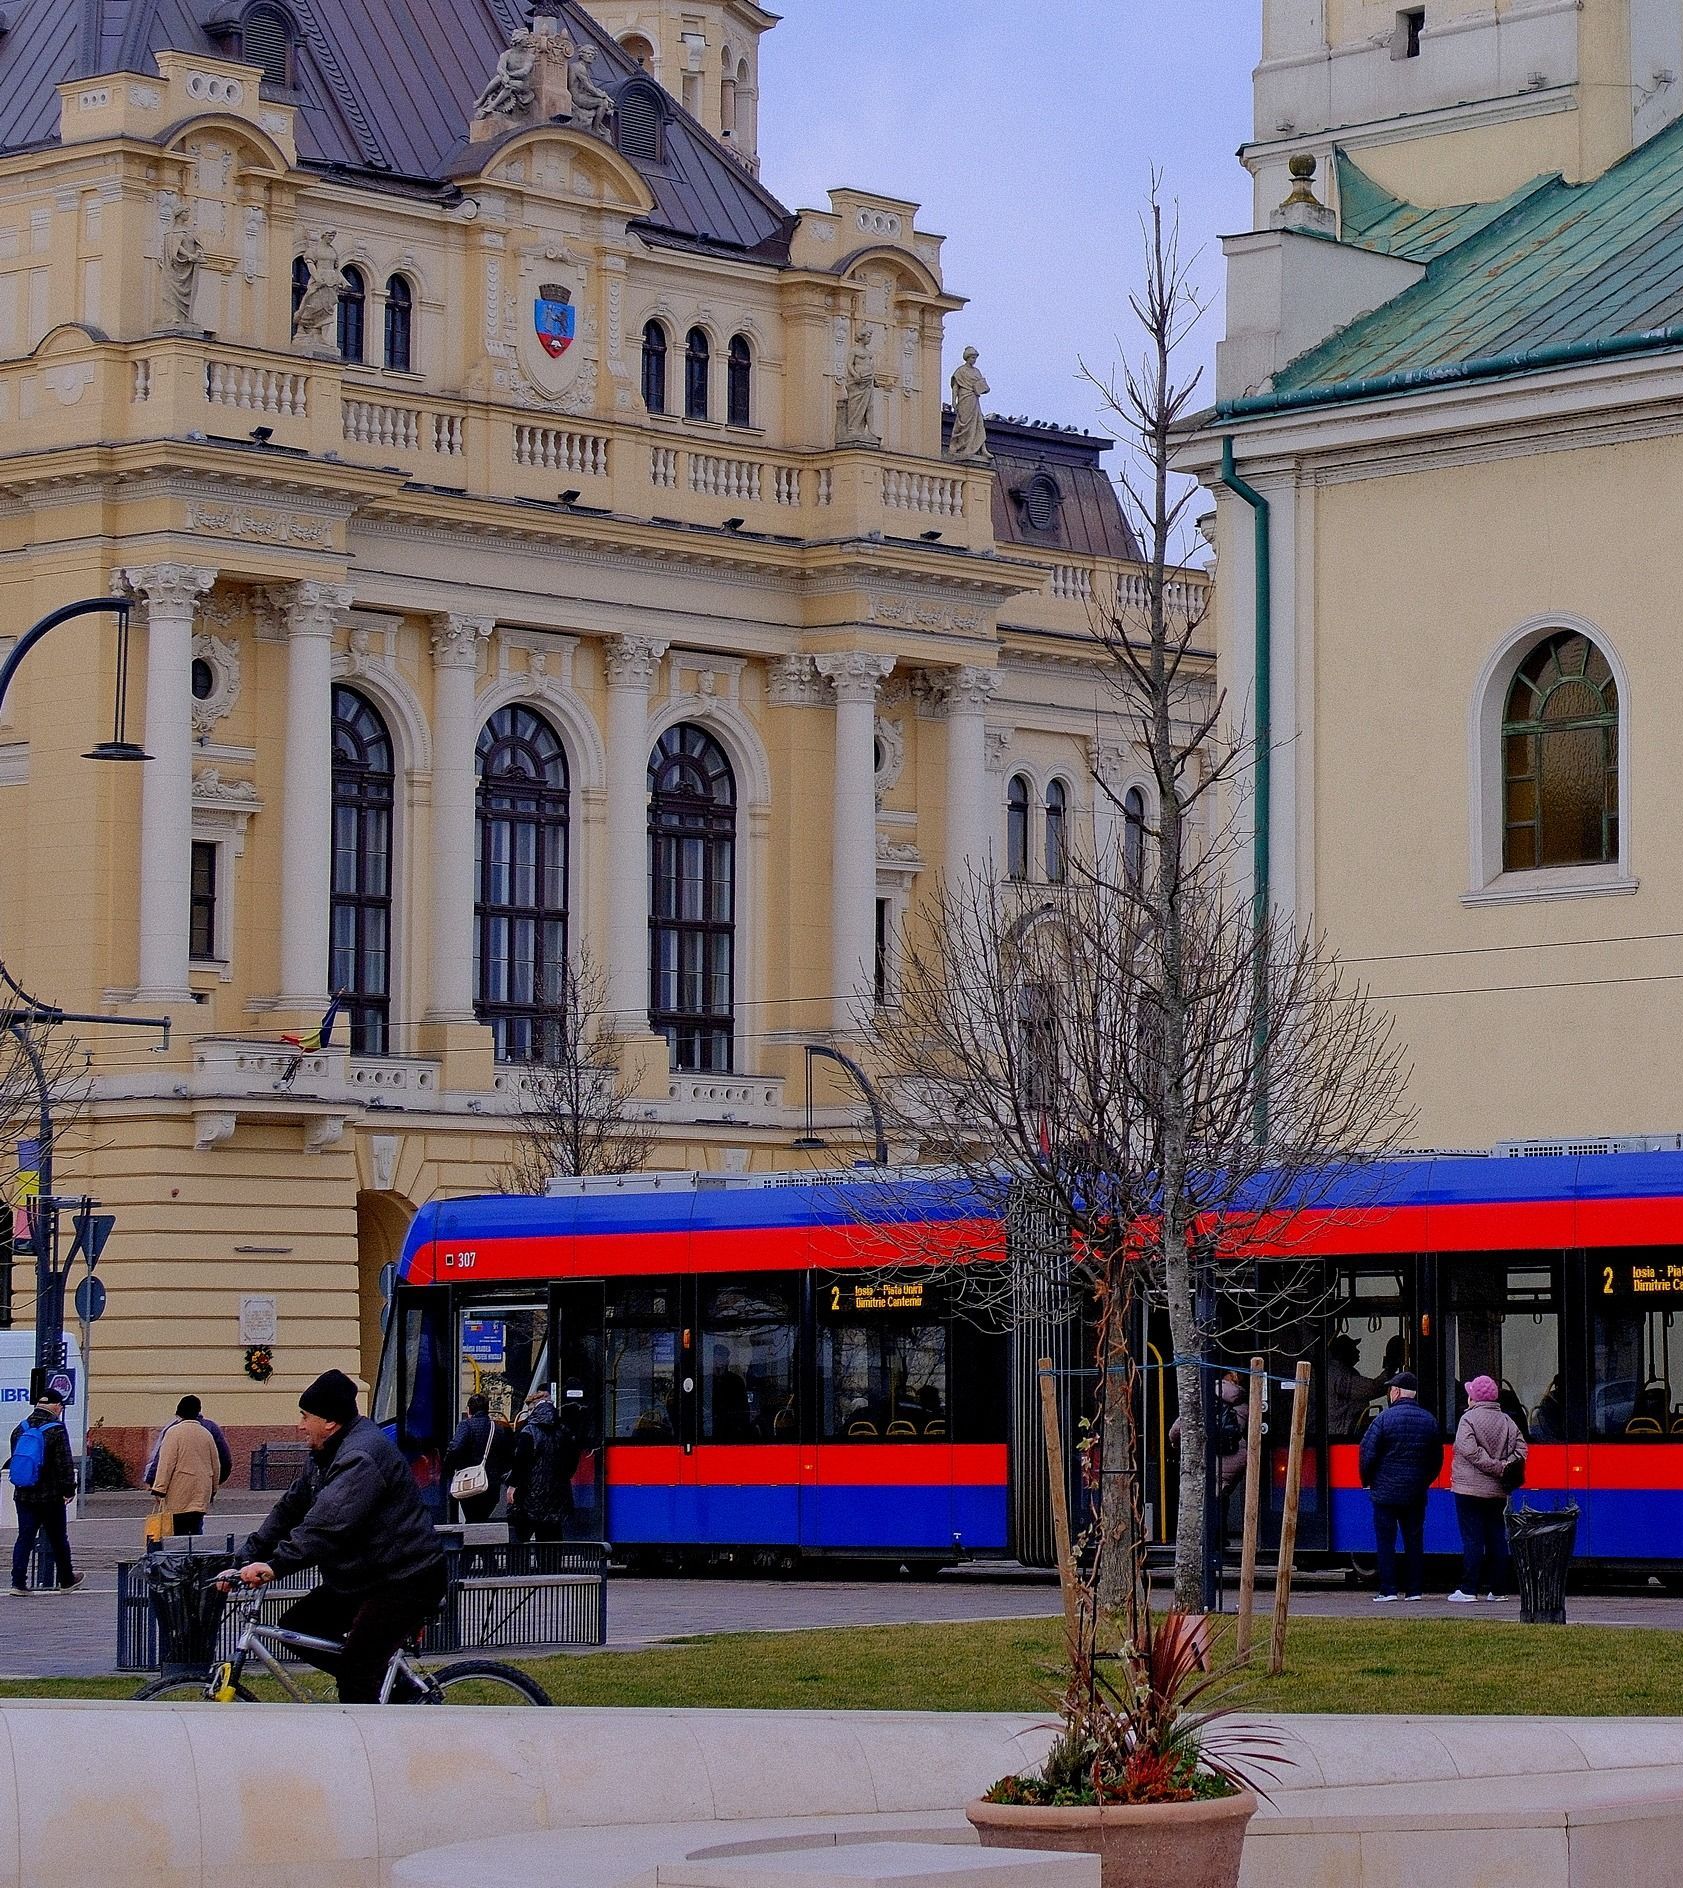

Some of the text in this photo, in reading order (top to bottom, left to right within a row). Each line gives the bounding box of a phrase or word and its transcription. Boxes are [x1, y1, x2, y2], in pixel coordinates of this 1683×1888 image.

[458, 1252, 476, 1268] 307
[1603, 1266, 1614, 1294] 2
[1632, 1265, 1655, 1278] Iosia
[1633, 1278, 1671, 1292] Dimitrie
[831, 1285, 840, 1310] 2
[887, 1295, 922, 1307] Cantemir
